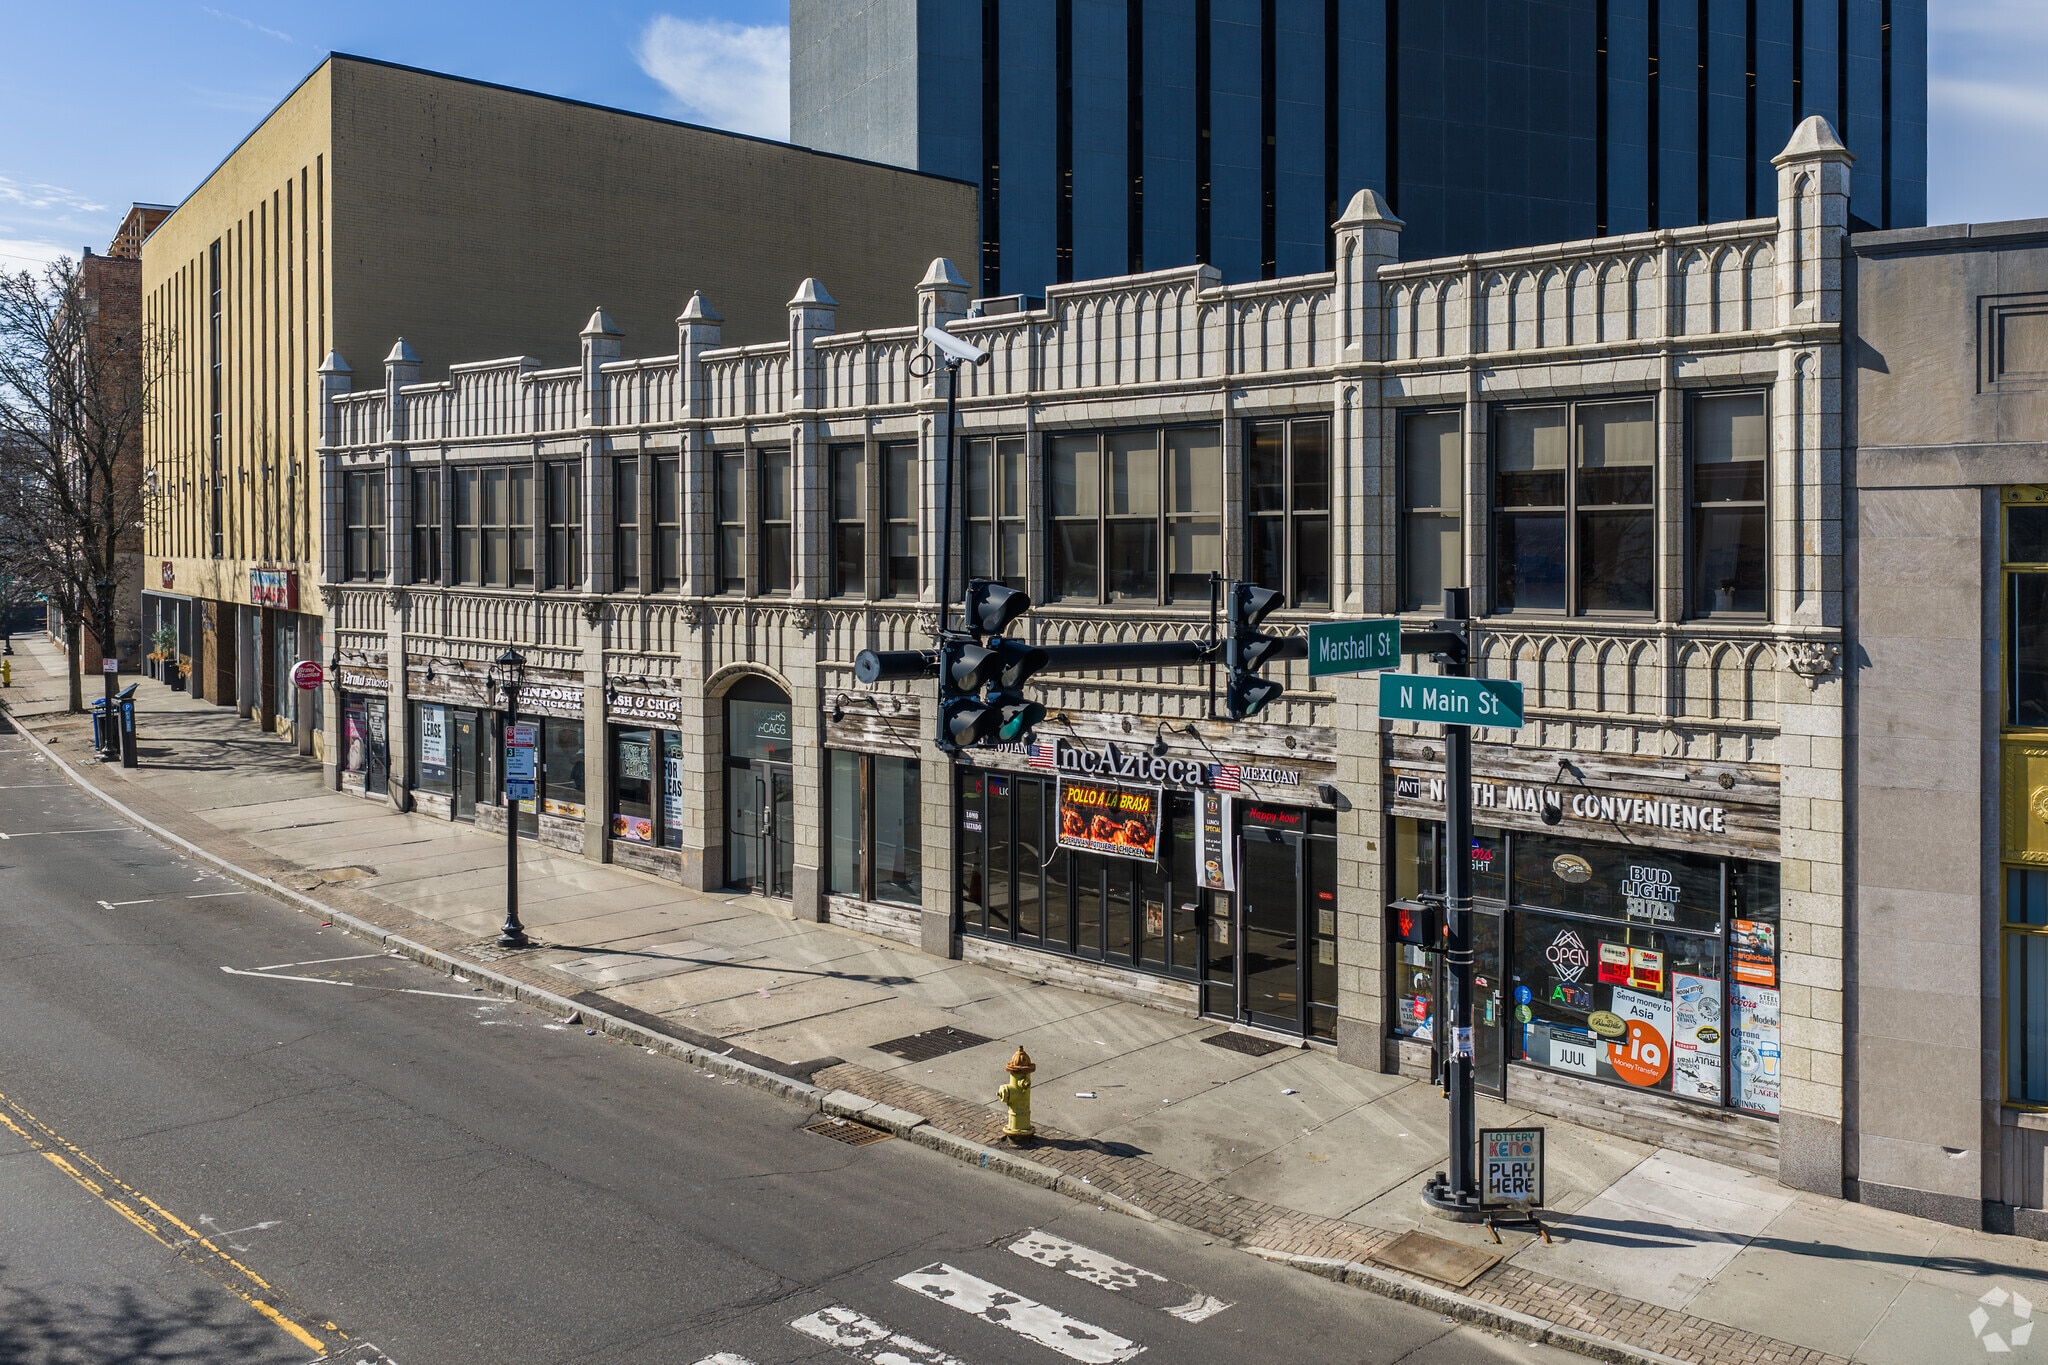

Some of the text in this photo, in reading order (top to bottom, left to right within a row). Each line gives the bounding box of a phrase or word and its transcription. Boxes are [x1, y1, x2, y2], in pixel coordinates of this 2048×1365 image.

[1319, 632, 1391, 662] Marshall St
[532, 699, 582, 710] CHICKEN
[635, 696, 645, 708] &
[1400, 686, 1499, 715] N Main St
[423, 706, 435, 722] FOR
[612, 707, 678, 721] SEAFOOD
[753, 709, 786, 721] ROGERS
[423, 722, 442, 738] LEASE
[508, 748, 514, 757] 3
[1240, 766, 1301, 786] MEXICAN
[1398, 780, 1419, 794] ANT
[1067, 788, 1150, 812] POLLO A LA BRASA
[1430, 778, 1496, 807] NTH
[1572, 793, 1724, 832] CONVENIENCE
[1206, 818, 1220, 826] LUNCH
[1249, 807, 1300, 824] Happy hour
[1205, 825, 1222, 833] SPECIAL
[1118, 845, 1146, 857] CHICKEN
[1630, 865, 1672, 886] BUD
[1621, 880, 1680, 903] LIGHT
[1546, 945, 1589, 967] OPEN
[1732, 951, 1773, 963] Bangladesh
[1552, 986, 1590, 1007] ATM
[1616, 990, 1635, 1003] Send
[1636, 996, 1663, 1011] money
[1663, 1003, 1671, 1012] to
[1731, 995, 1757, 1009] Coors
[1759, 994, 1778, 1003] STEEL
[1630, 1005, 1654, 1020] Asia
[1752, 1013, 1777, 1026] Modelo
[1731, 1028, 1760, 1039] Corona
[1614, 1028, 1661, 1067] ria
[1559, 1048, 1586, 1067] JUUL
[1695, 1056, 1721, 1068] TRULY
[1613, 1058, 1659, 1077] Money Transfer
[1753, 1087, 1779, 1099] LAGER
[1730, 1097, 1766, 1111] GUINNESS
[1490, 1133, 1535, 1142] LOTTERY
[1489, 1142, 1535, 1157] KENO
[1489, 1162, 1535, 1178] PLAY
[1489, 1178, 1535, 1194] HERE
